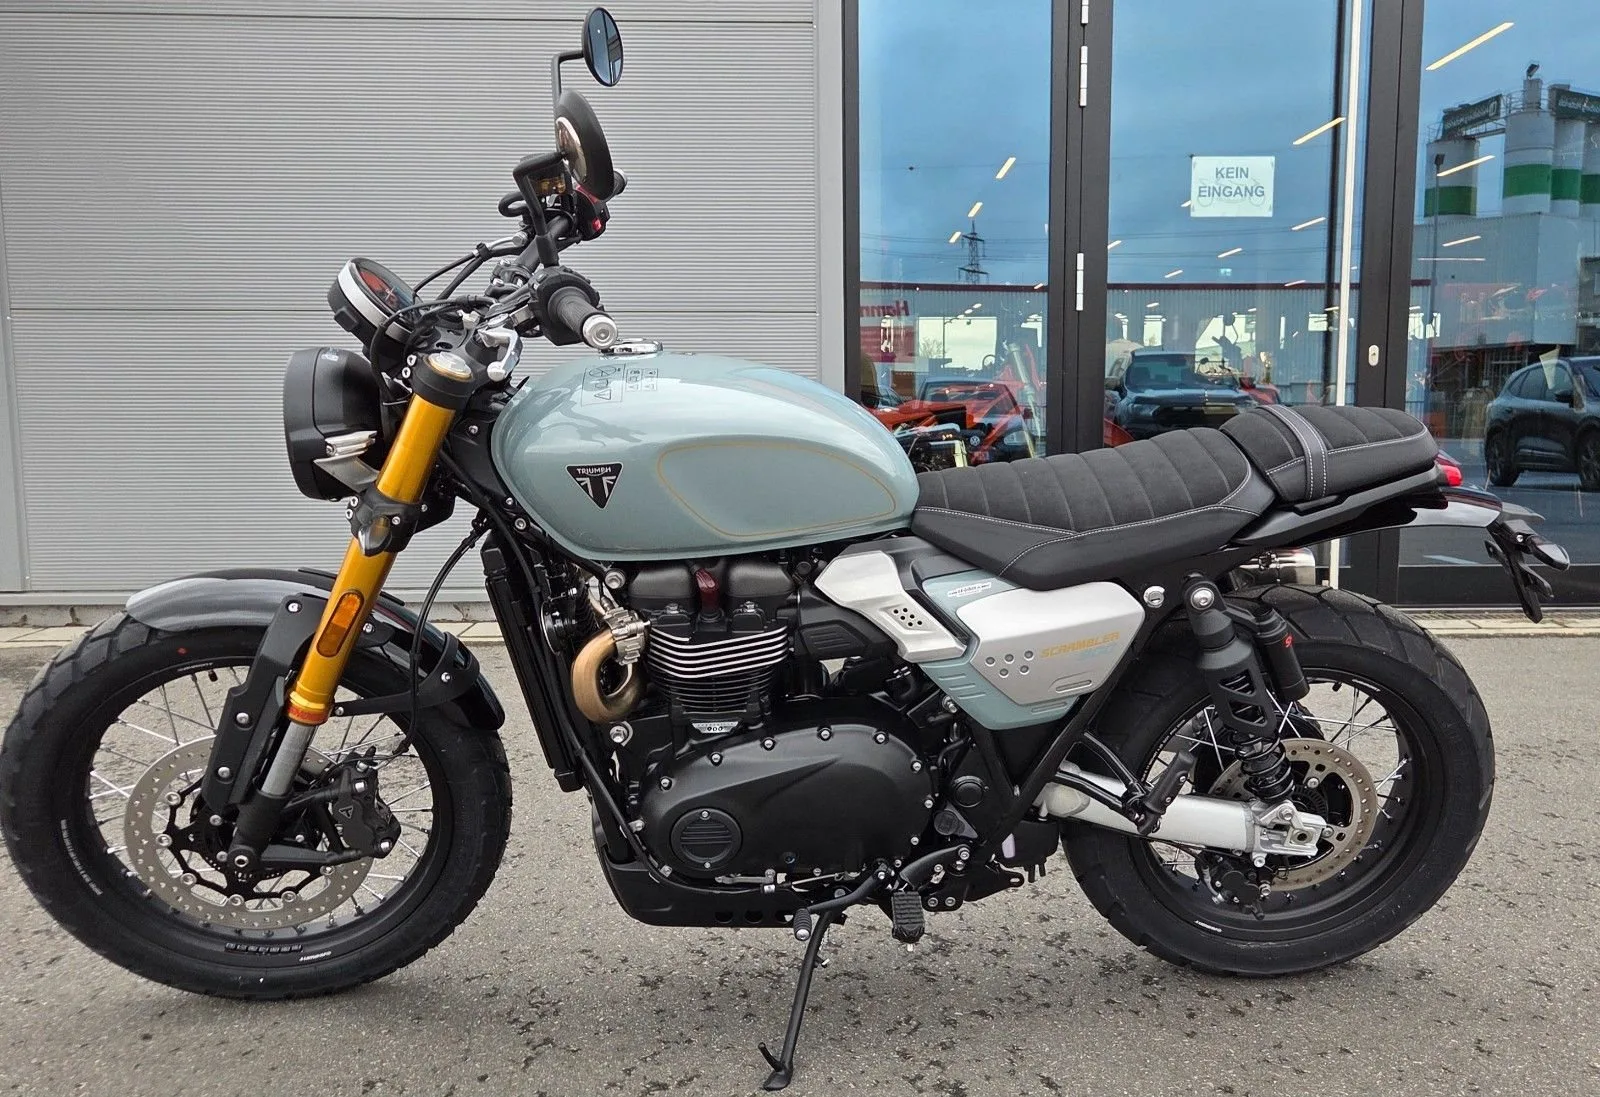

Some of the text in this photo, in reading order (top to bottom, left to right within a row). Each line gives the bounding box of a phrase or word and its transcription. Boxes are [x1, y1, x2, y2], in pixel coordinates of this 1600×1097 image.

[1215, 167, 1249, 179] KEIN
[1198, 186, 1265, 198] EINGANG
[576, 466, 612, 475] TRIUMPH
[1041, 631, 1120, 658] SCRAMBLER
